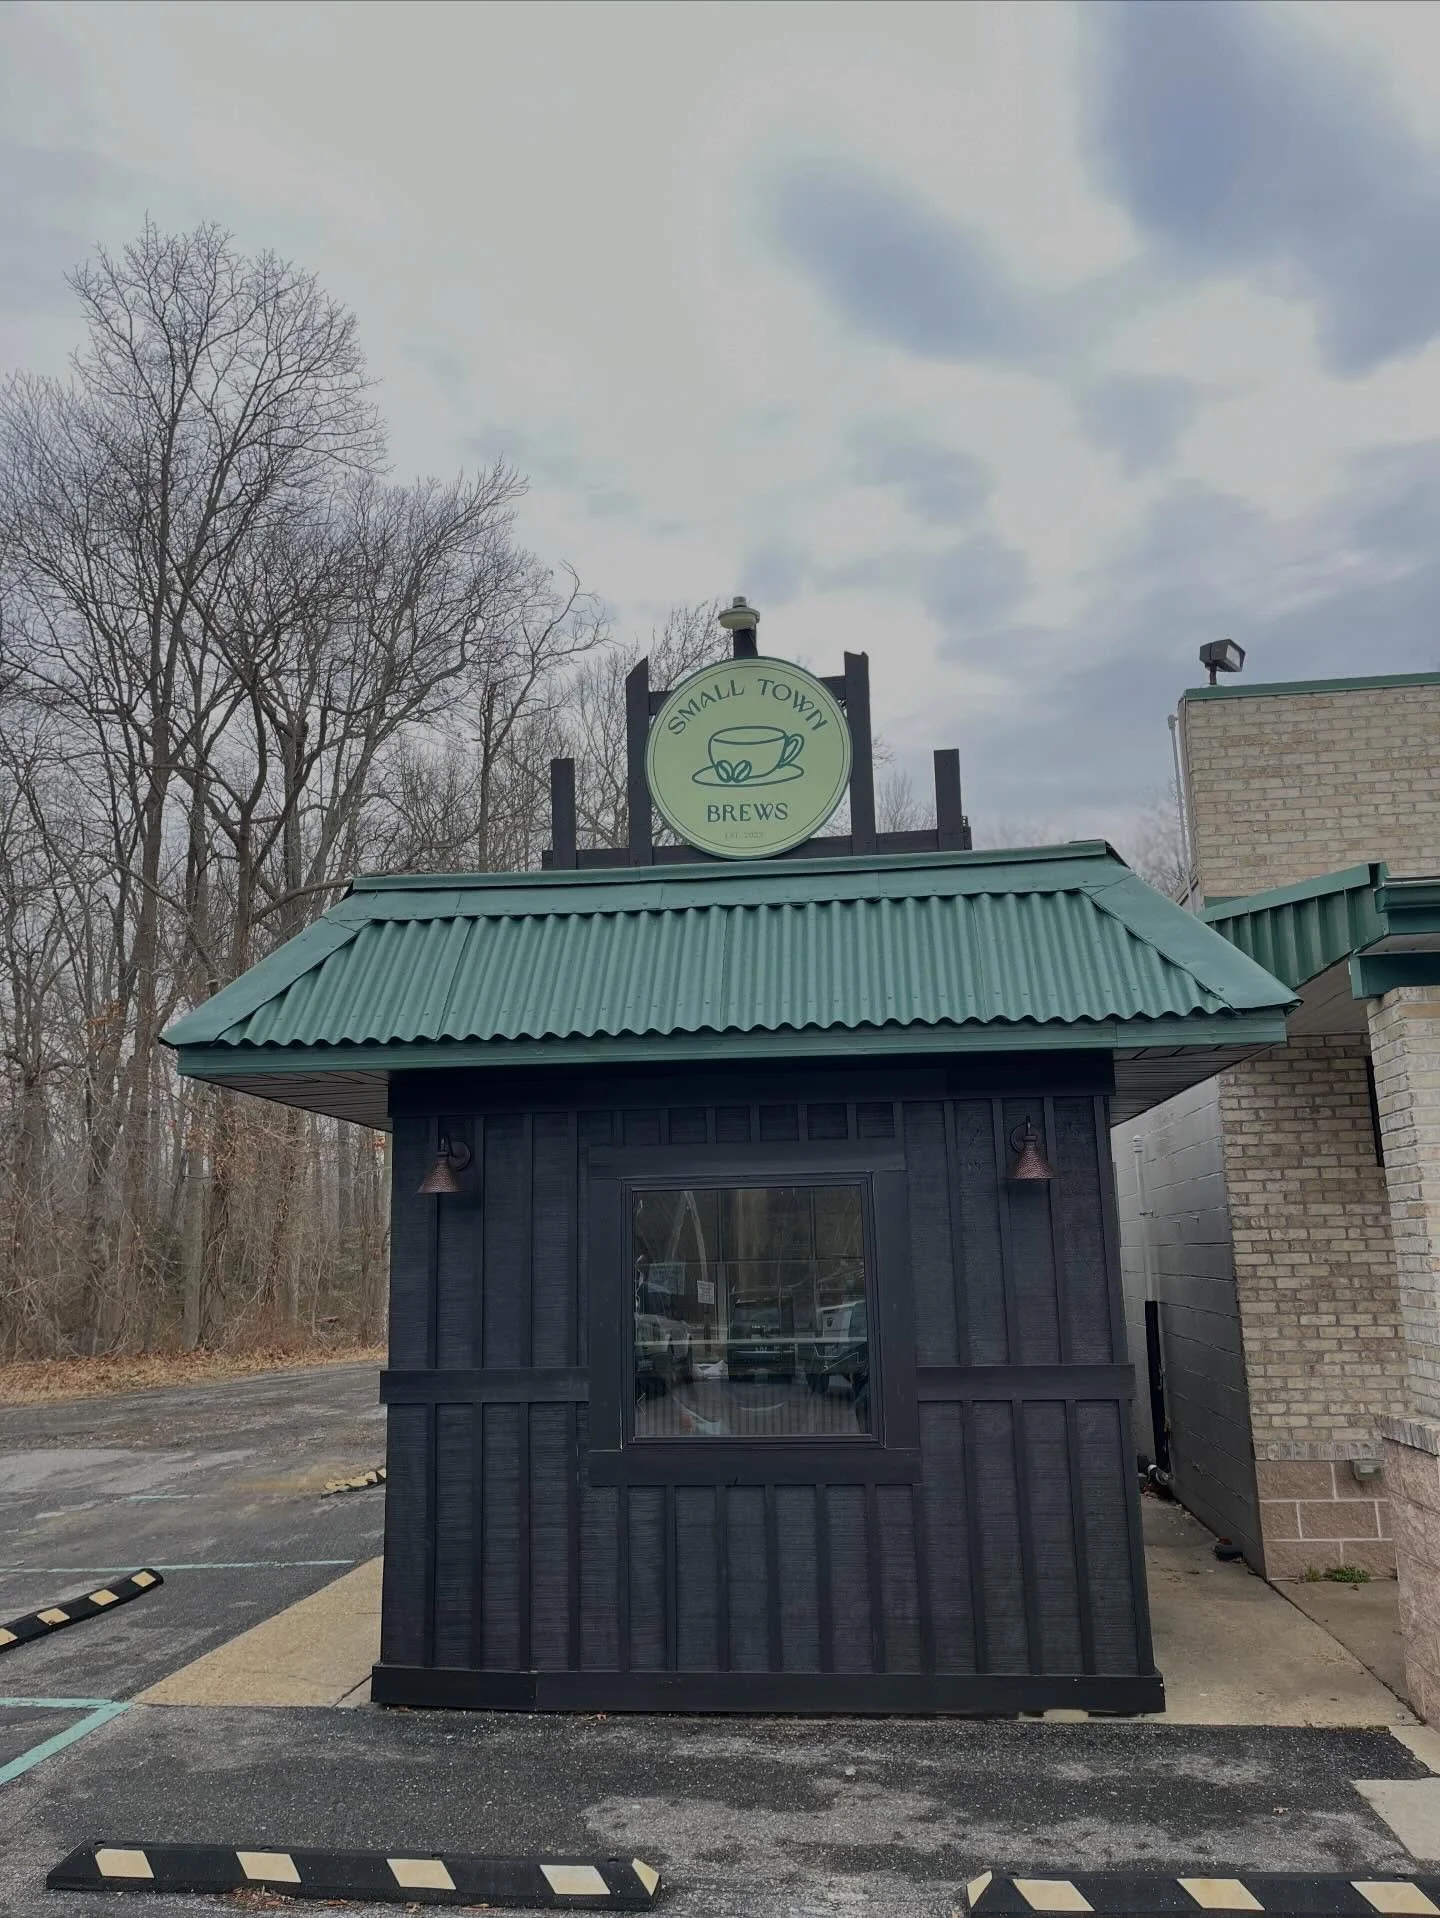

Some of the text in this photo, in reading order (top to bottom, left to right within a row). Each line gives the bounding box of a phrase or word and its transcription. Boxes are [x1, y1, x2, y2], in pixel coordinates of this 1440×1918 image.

[667, 678, 828, 735] SMALL TOWN
[707, 803, 789, 823] BREWS
